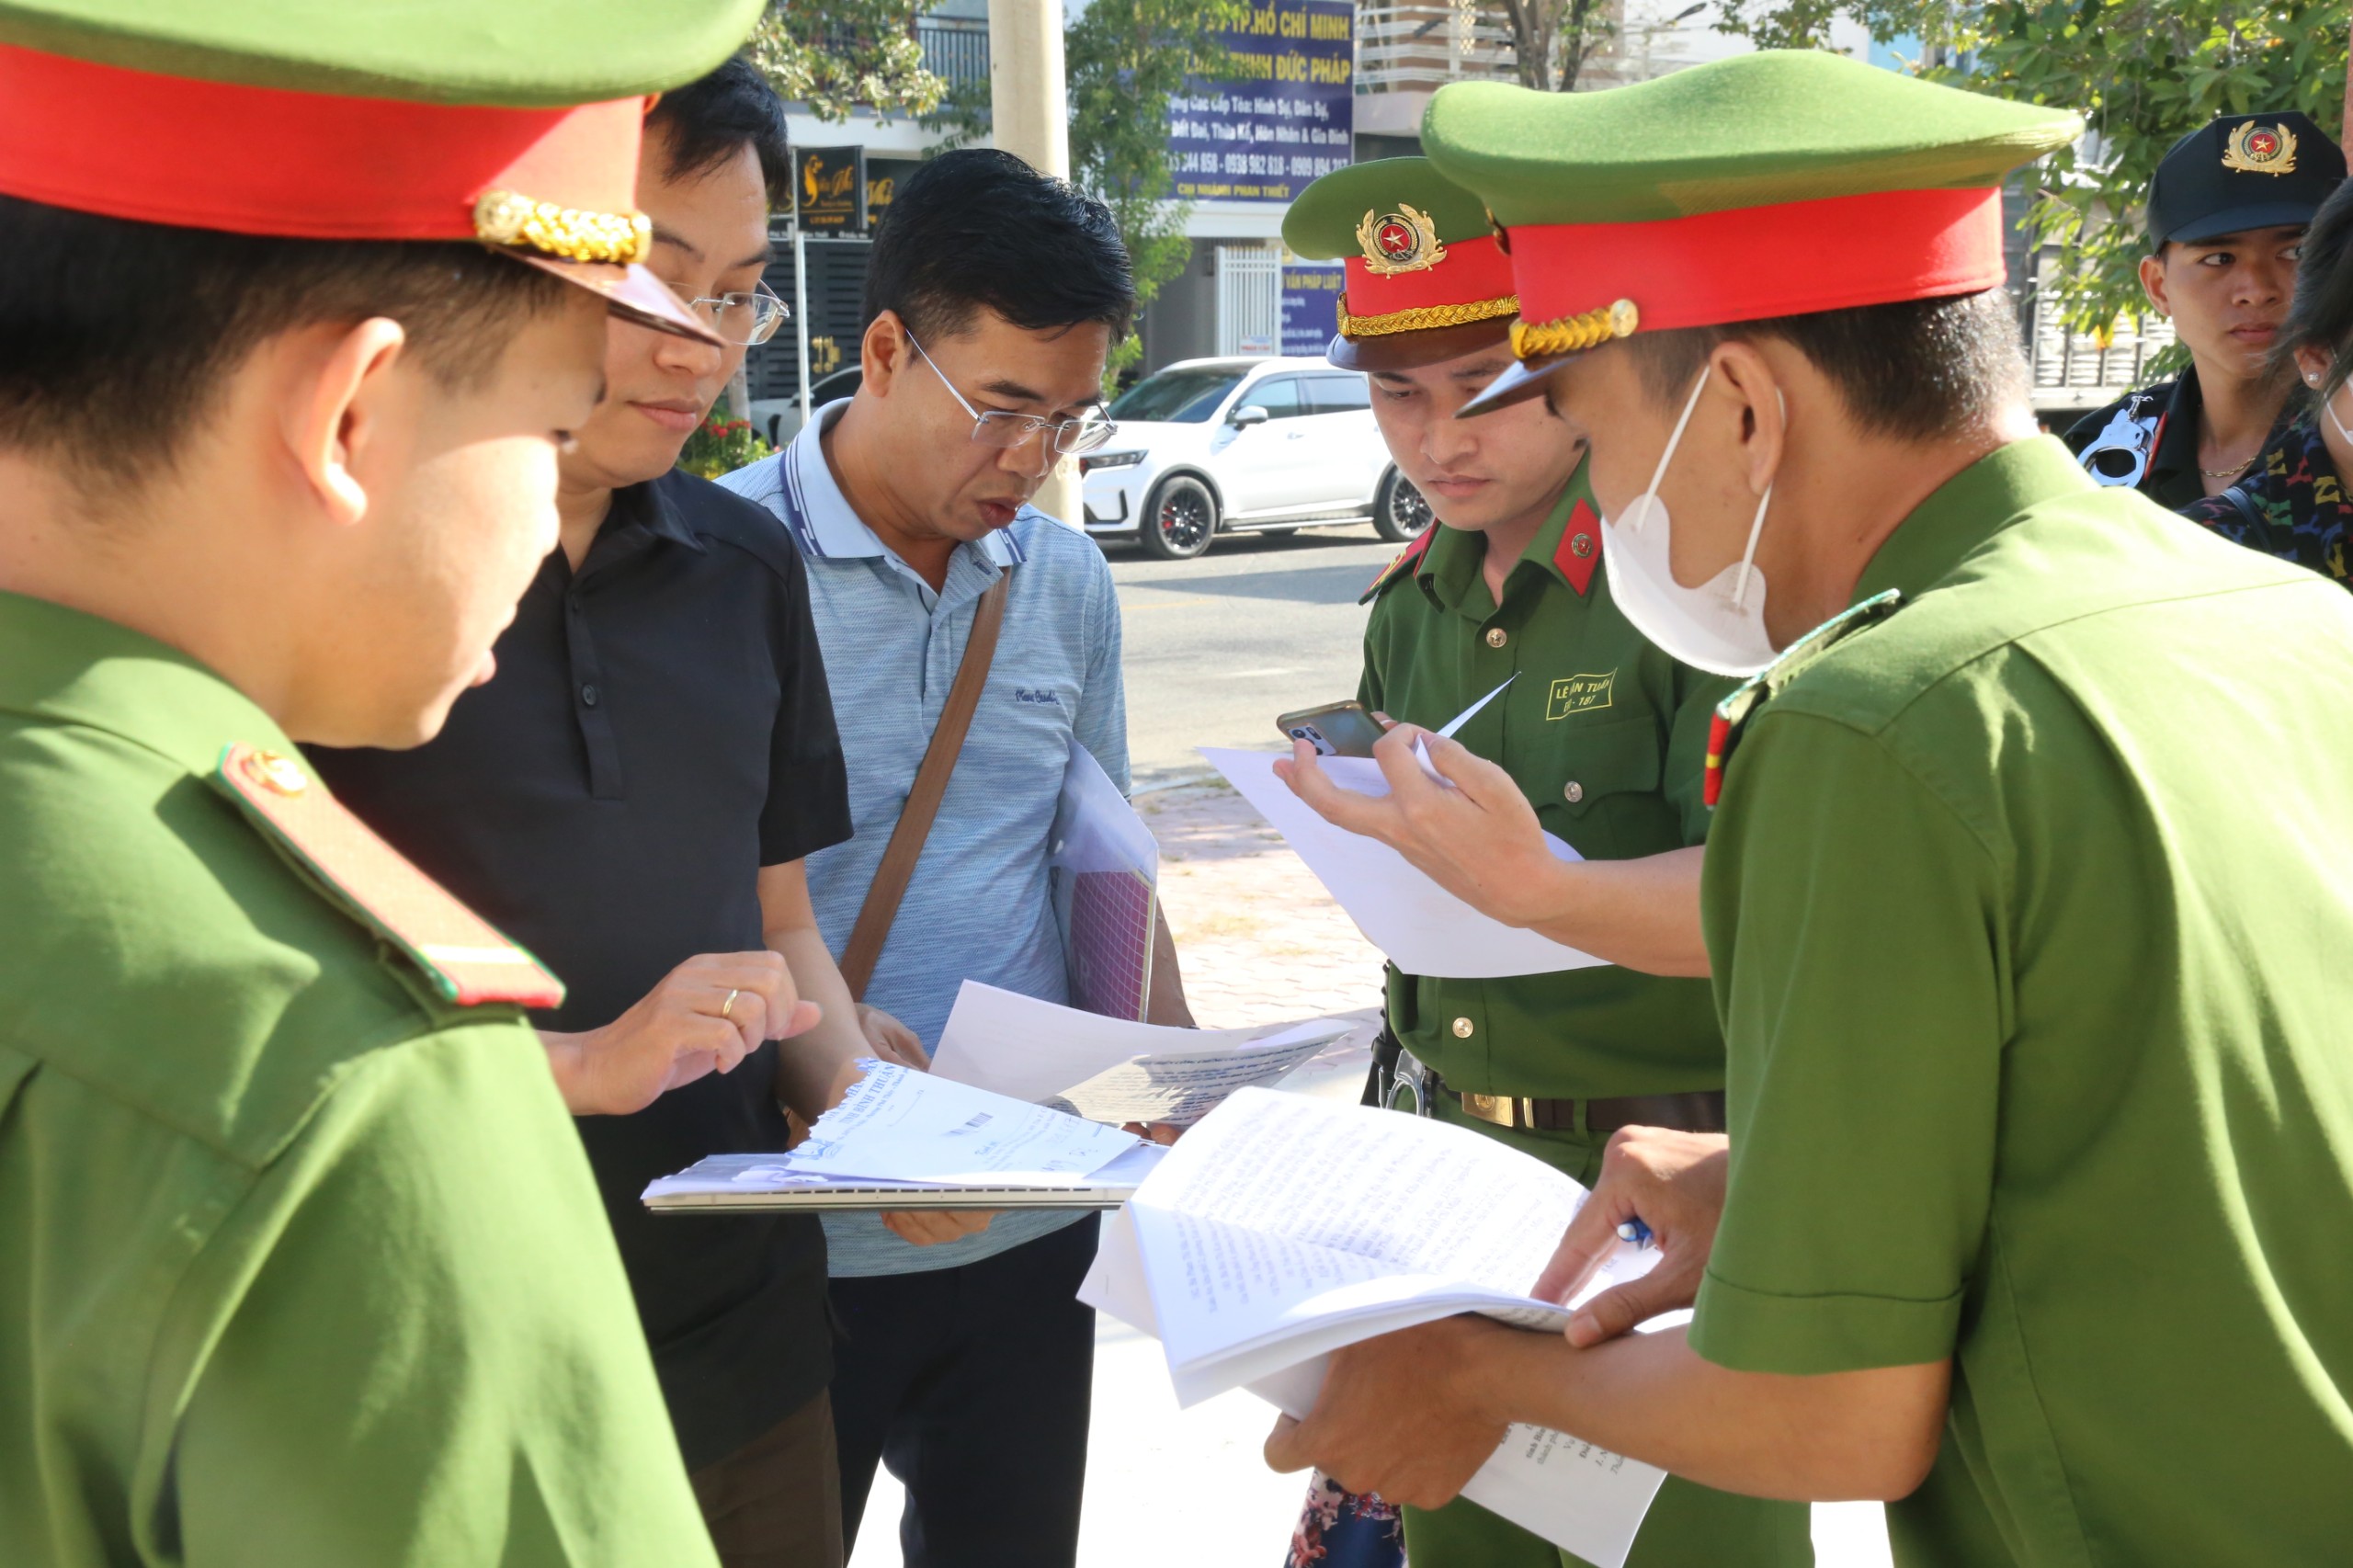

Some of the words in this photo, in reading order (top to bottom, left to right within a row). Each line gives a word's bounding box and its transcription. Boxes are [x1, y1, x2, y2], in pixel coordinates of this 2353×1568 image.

[1279, 6, 1307, 39] CHÍ
[1276, 49, 1307, 83] ĐỨC
[1310, 51, 1351, 85] PHÁP
[870, 1063, 897, 1095] THUẬN
